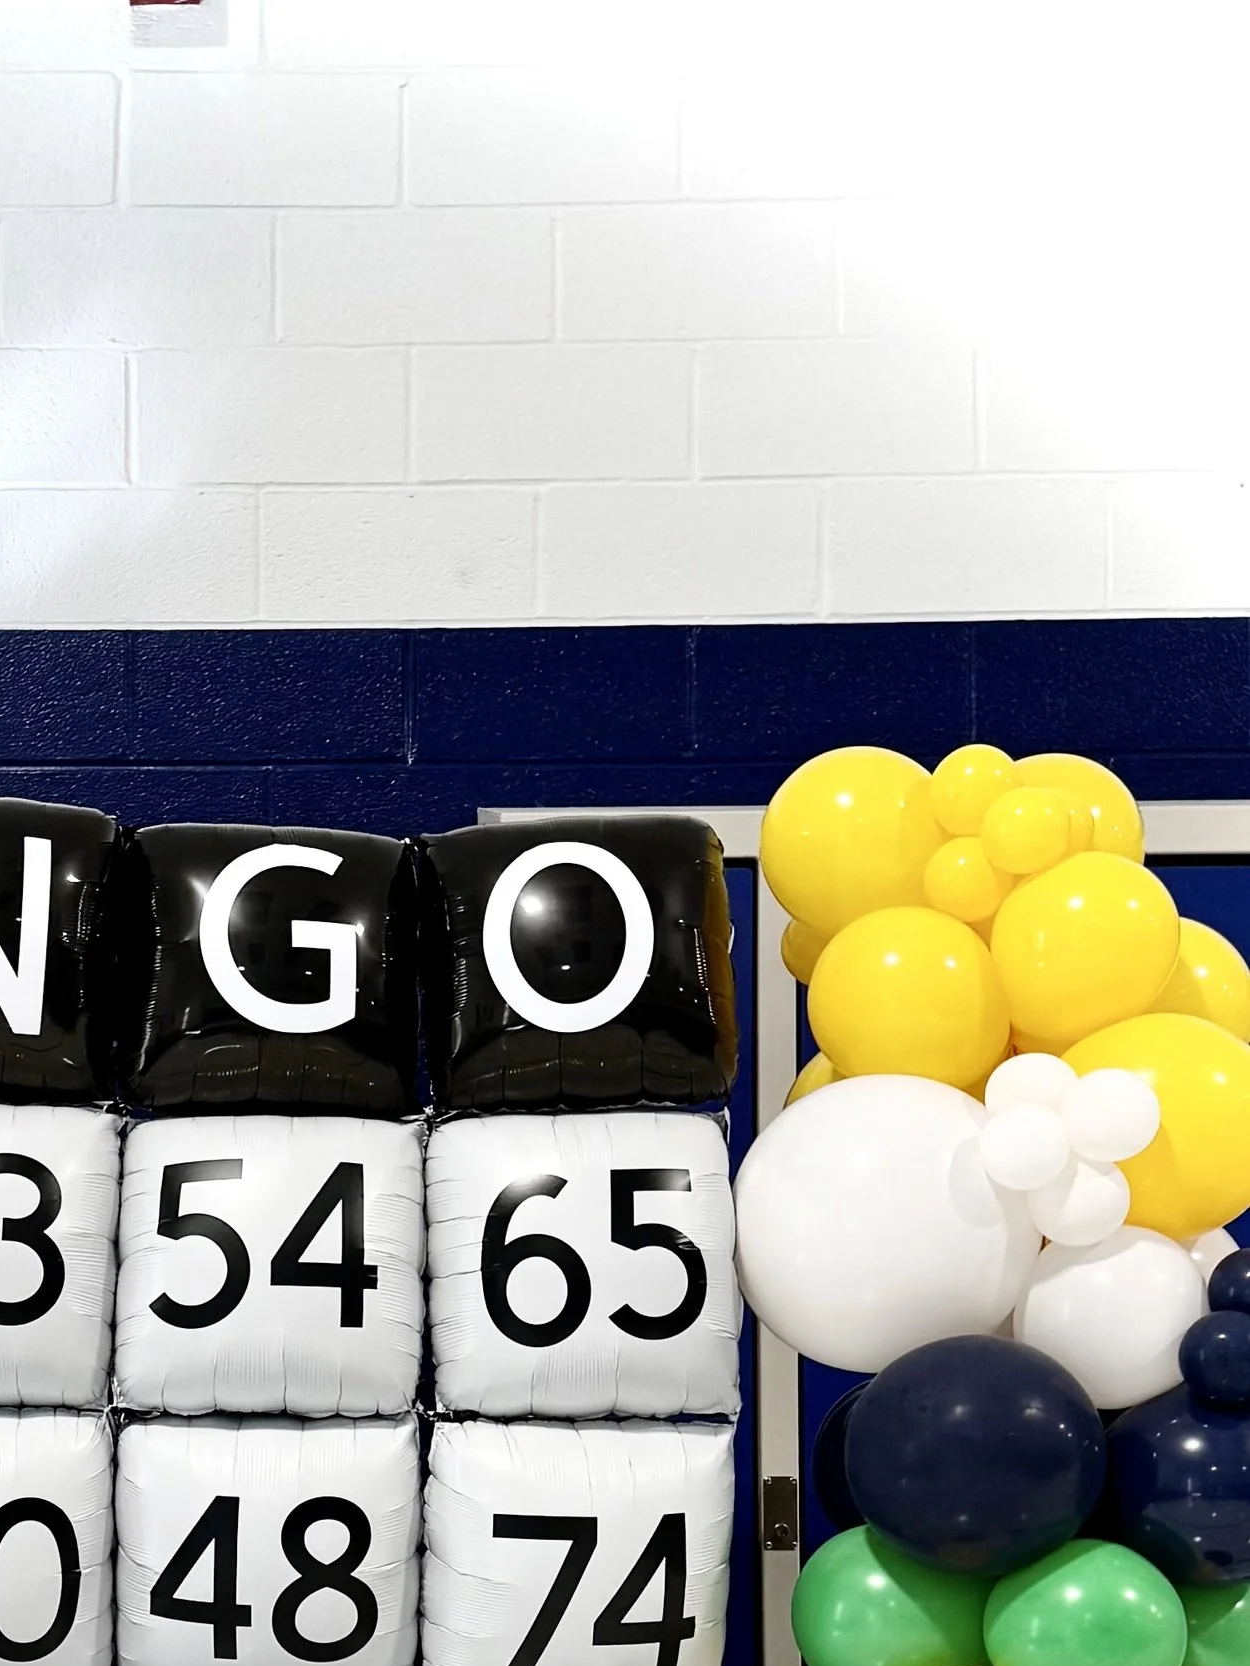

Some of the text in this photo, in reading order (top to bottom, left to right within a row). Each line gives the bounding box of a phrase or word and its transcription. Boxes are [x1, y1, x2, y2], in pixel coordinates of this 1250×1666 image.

[149, 1159, 378, 1329] 54
[480, 1169, 707, 1347] 65
[150, 1496, 378, 1662] 48
